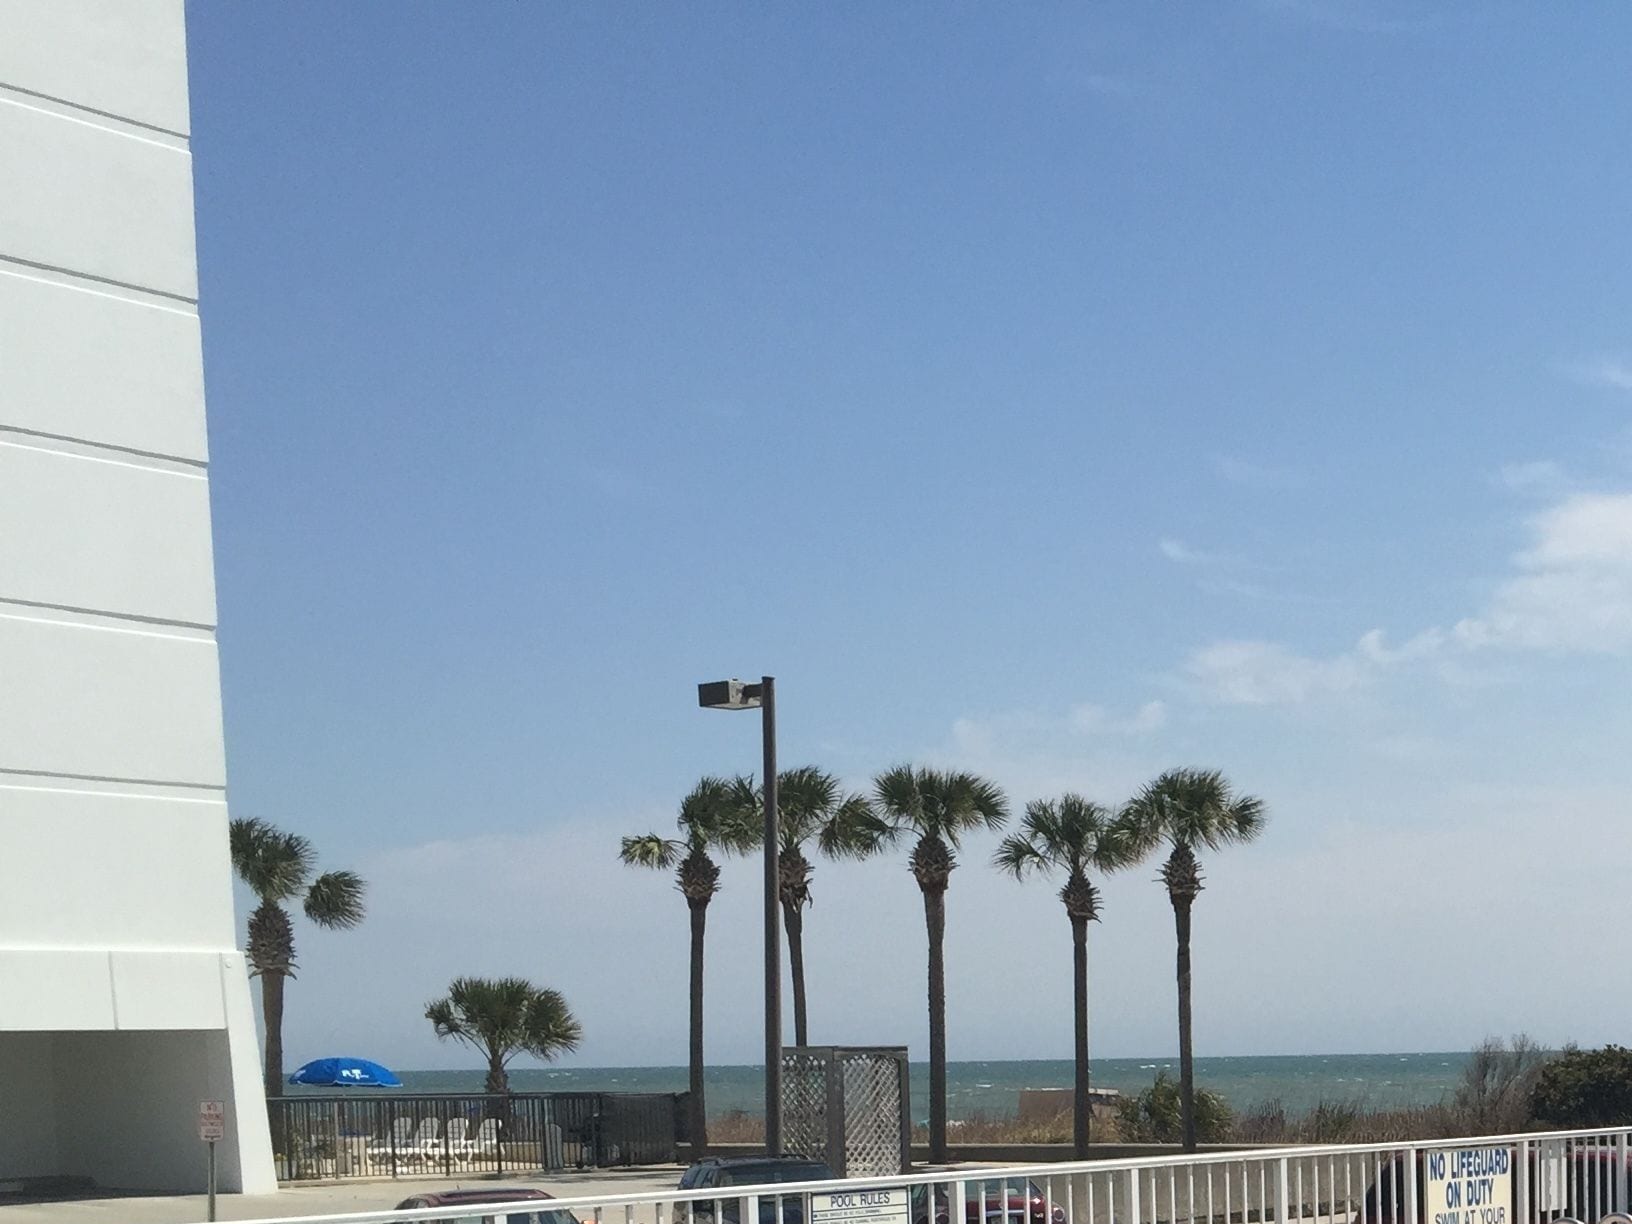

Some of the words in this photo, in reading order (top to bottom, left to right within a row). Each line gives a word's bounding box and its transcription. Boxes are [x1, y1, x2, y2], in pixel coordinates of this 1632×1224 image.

[1430, 1152, 1446, 1180] NO
[1451, 1148, 1508, 1179] LIFEGUARD
[830, 1195, 857, 1208] POOL
[860, 1192, 890, 1206] RULES
[1446, 1181, 1461, 1209] ON
[1467, 1178, 1494, 1206] DUTY
